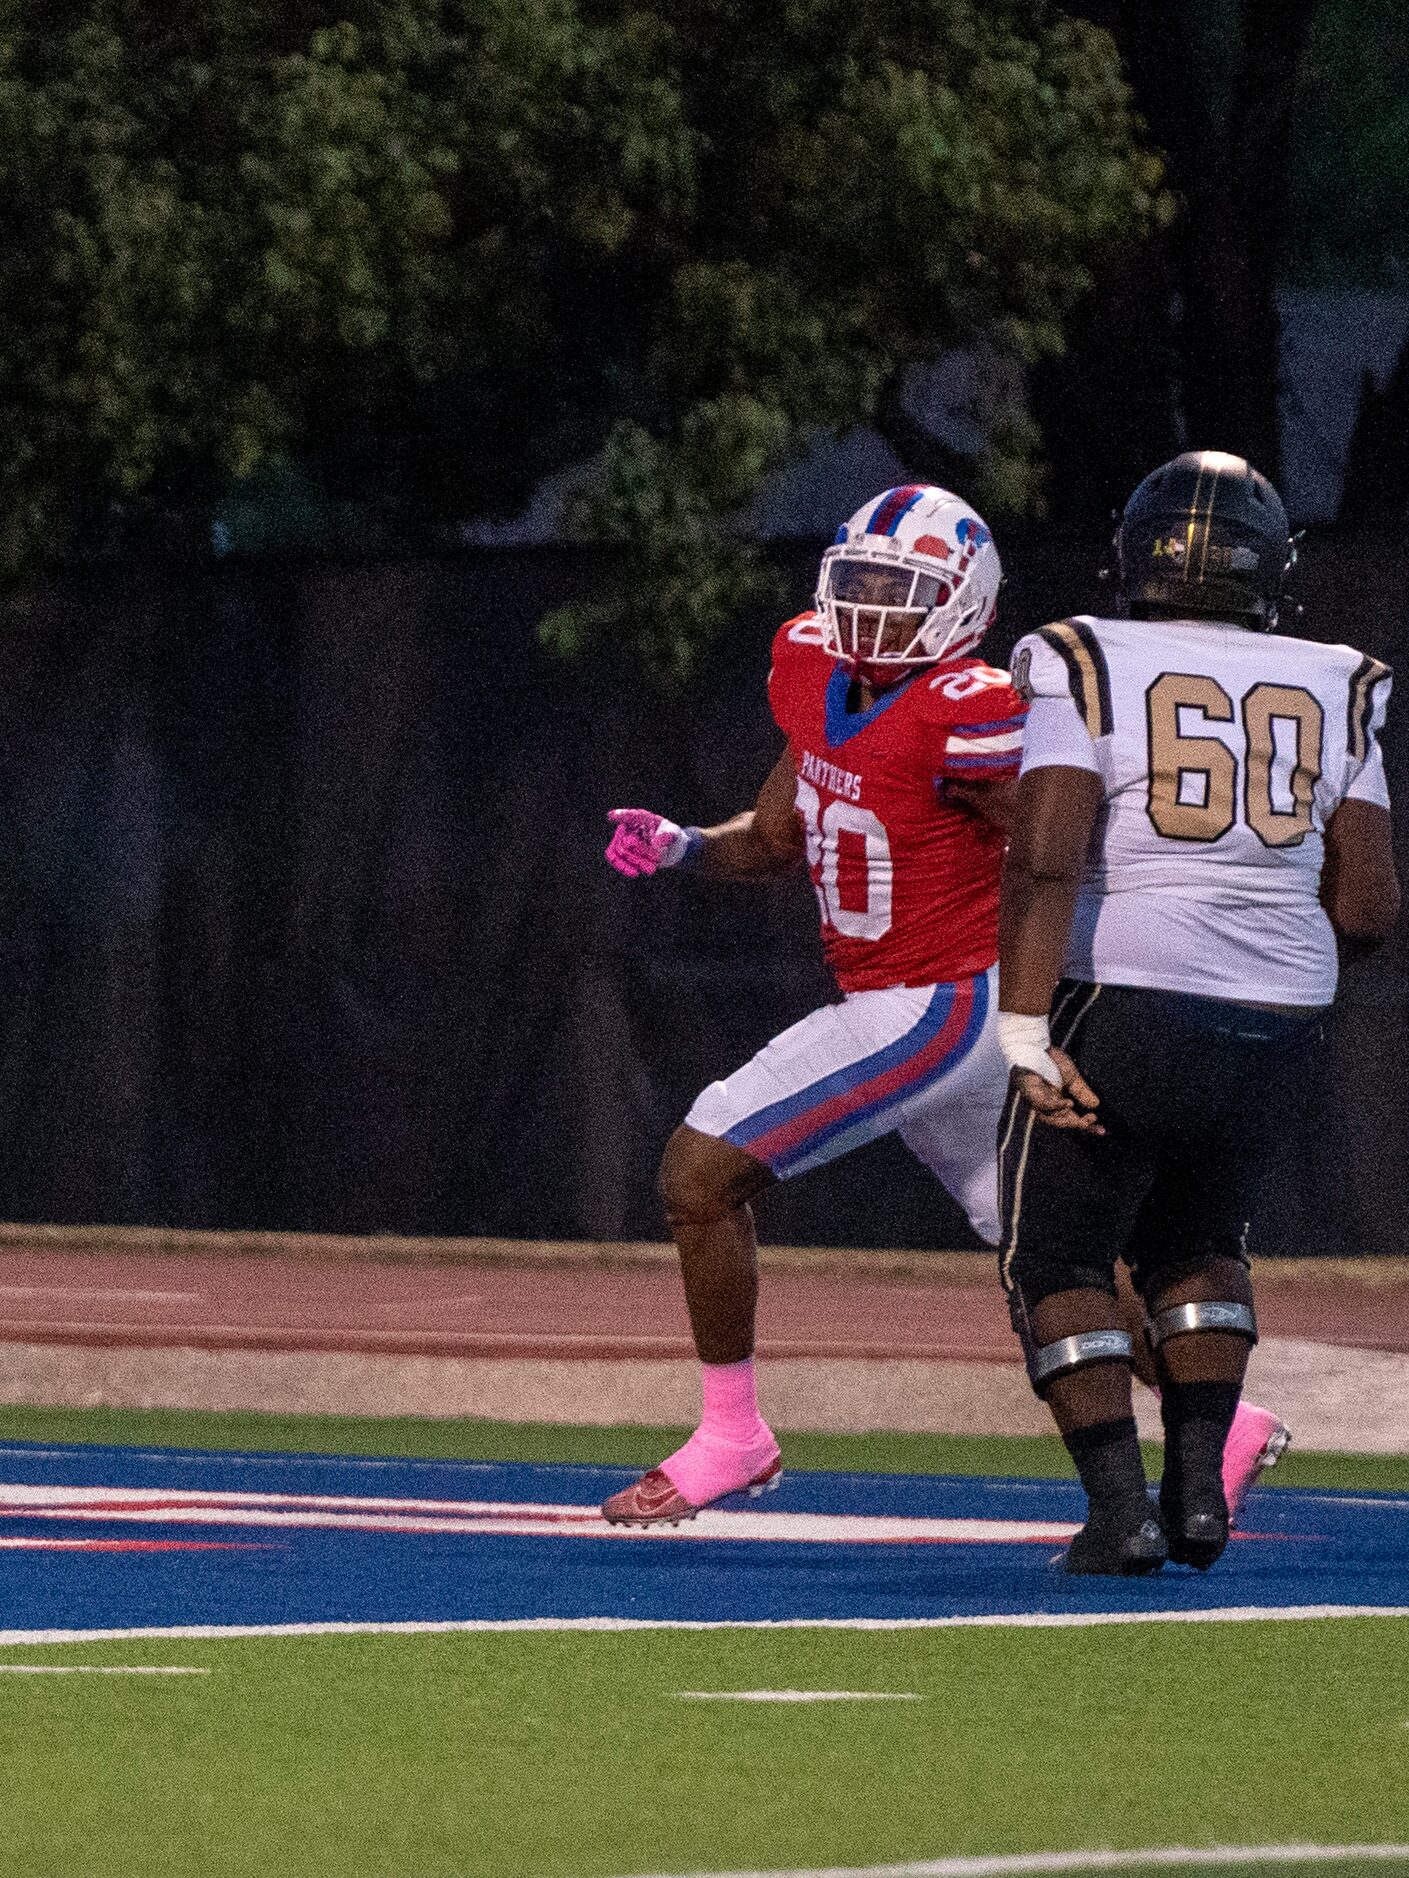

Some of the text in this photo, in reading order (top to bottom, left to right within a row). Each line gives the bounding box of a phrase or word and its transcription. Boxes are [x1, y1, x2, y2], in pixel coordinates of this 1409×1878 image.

[929, 665, 1012, 702] 20
[801, 750, 863, 802] PANTHERS
[1145, 671, 1325, 848] 60
